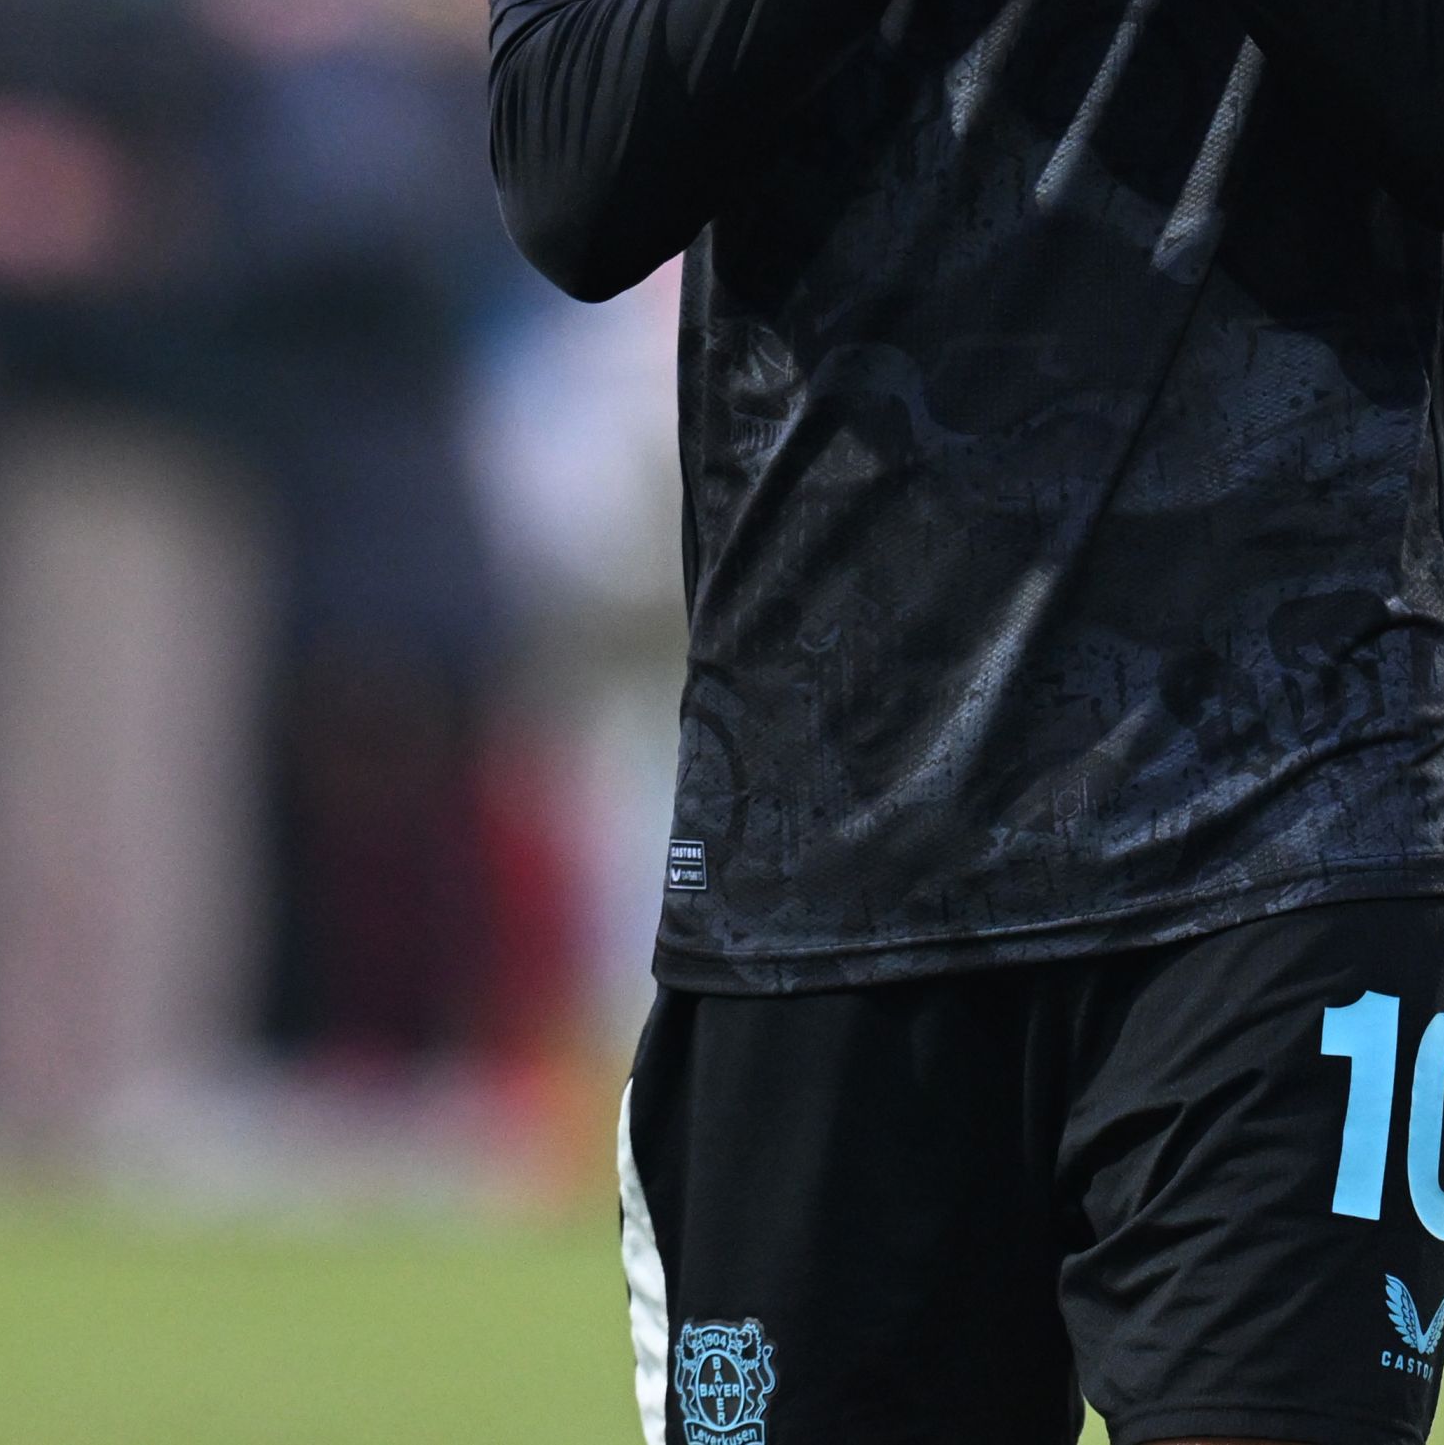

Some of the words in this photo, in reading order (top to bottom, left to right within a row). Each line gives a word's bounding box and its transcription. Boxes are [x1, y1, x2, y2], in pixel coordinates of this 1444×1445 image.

[703, 1333, 727, 1347] 1904
[699, 1384, 740, 1397] BAYER
[713, 1357, 726, 1424] BAYER
